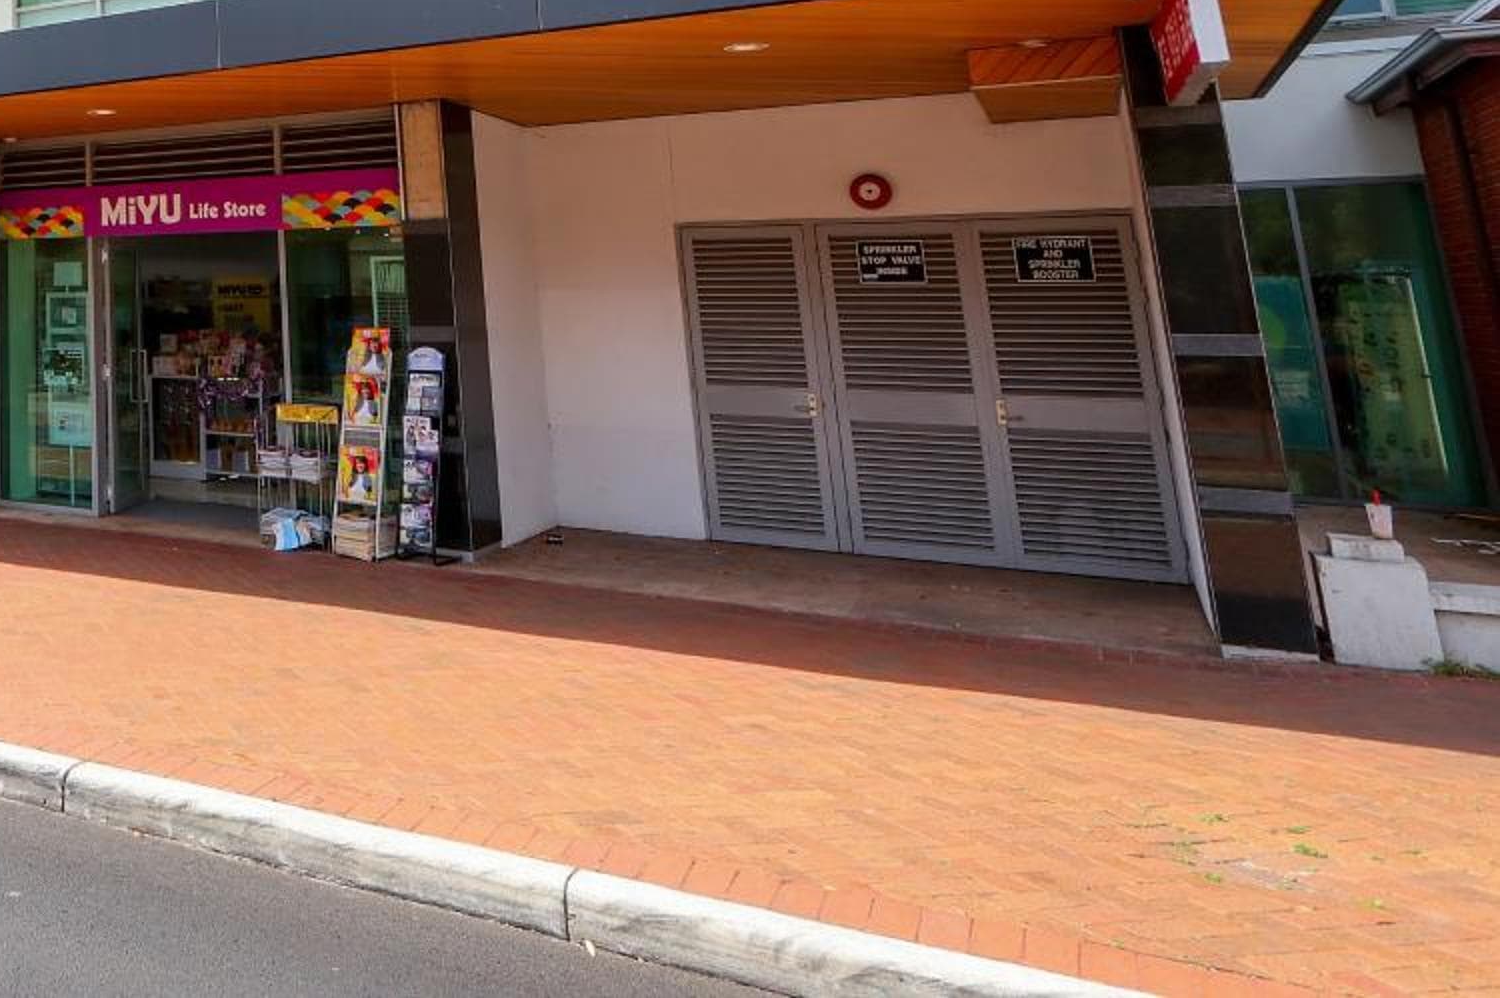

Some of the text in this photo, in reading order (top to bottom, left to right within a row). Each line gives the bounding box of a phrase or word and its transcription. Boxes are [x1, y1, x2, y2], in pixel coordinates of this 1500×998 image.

[100, 193, 267, 227] MiYU Life Store
[861, 255, 921, 264] STOP VALVE
[1033, 269, 1079, 279] BOOSTER
